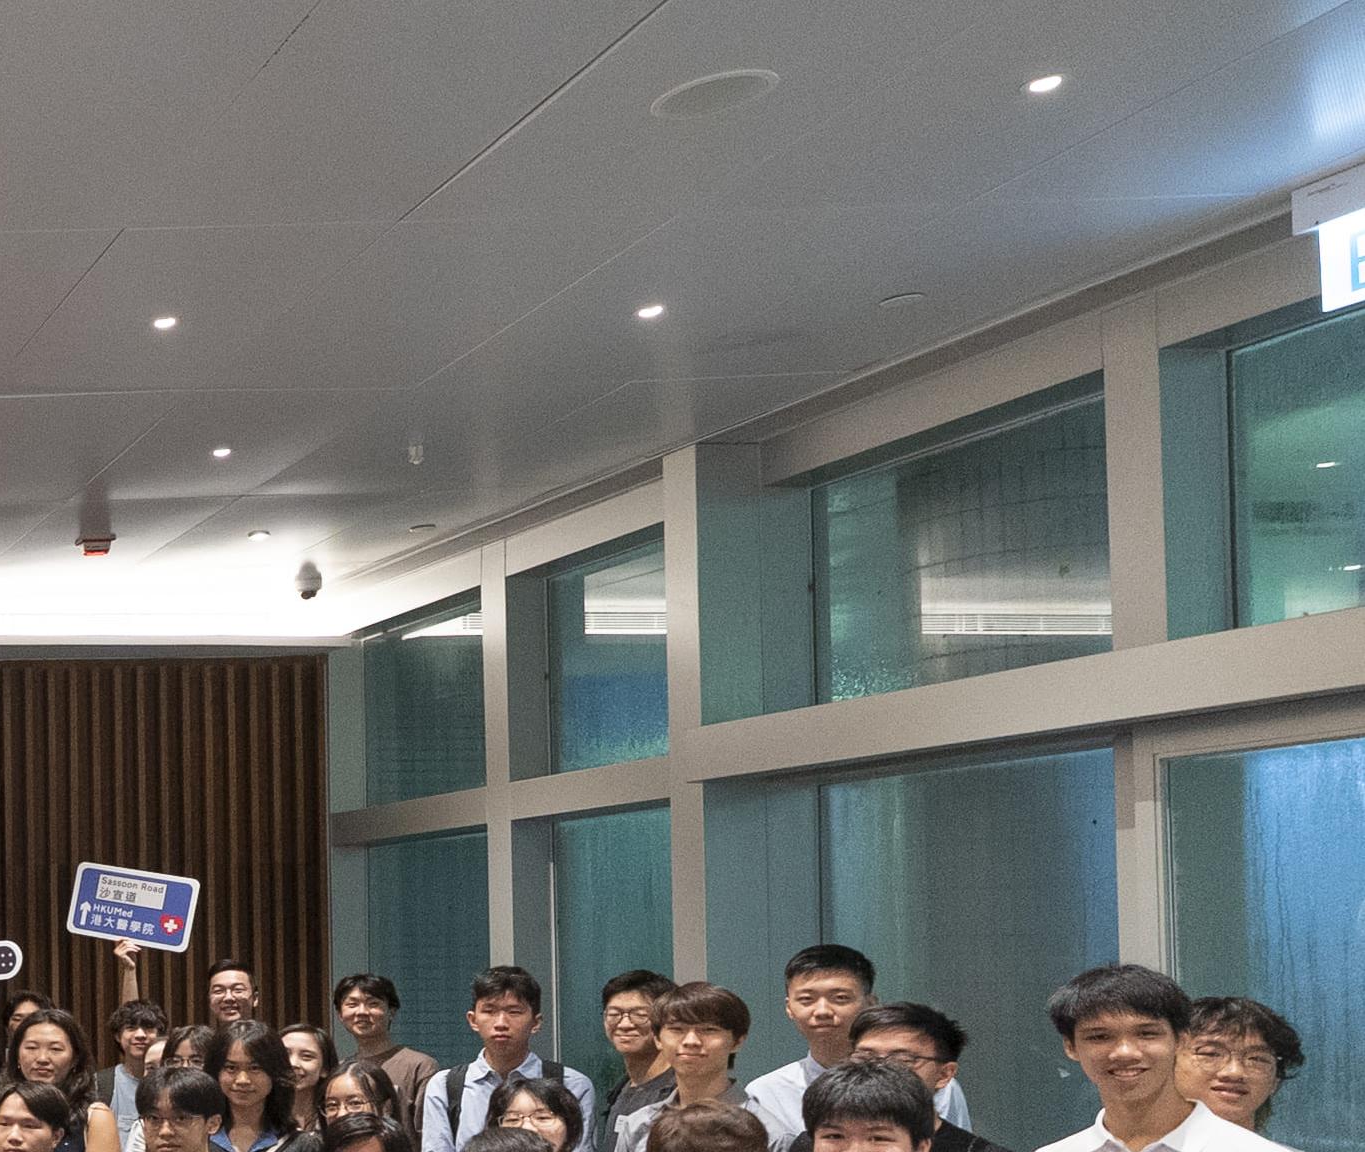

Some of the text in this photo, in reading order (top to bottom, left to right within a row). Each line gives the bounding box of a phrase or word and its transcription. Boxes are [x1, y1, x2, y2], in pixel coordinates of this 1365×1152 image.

[101, 876, 164, 894] Sassoon Road
[93, 904, 134, 917] HKUMed
